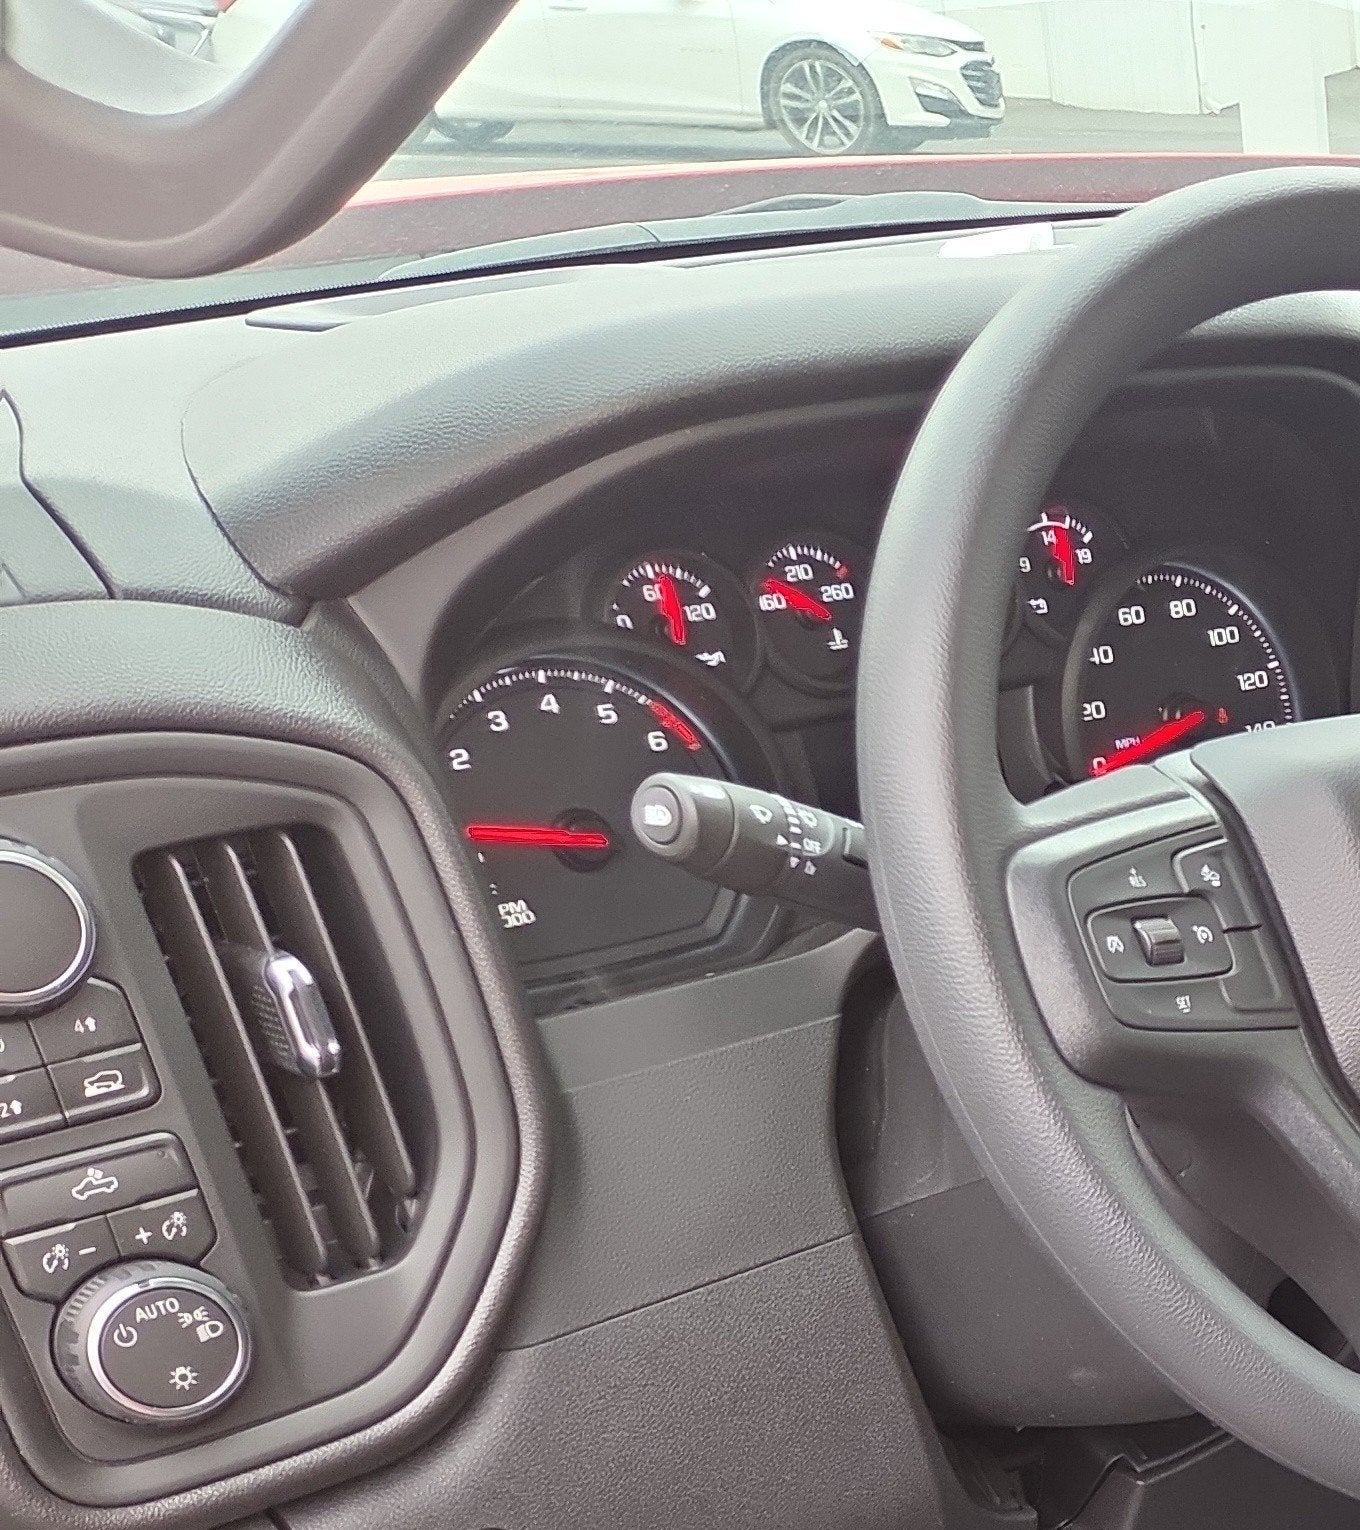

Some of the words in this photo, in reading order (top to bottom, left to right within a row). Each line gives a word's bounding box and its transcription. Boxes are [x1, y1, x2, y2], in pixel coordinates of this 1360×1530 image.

[1019, 556, 1031, 573] 9
[1075, 548, 1093, 565] 19
[784, 563, 813, 582] 210
[758, 592, 788, 612] 160
[821, 582, 855, 602] 260
[683, 602, 717, 622] 120
[1118, 605, 1146, 627] 60
[1169, 598, 1197, 620] 80
[1207, 625, 1241, 648] 100
[1236, 670, 1270, 691] 120
[540, 693, 560, 715] 4
[597, 703, 618, 726] 5
[487, 709, 509, 732] 3
[647, 731, 669, 753] 6
[449, 747, 472, 771] 2
[74, 1018, 85, 1034] 4
[135, 1297, 180, 1324] AUTO
